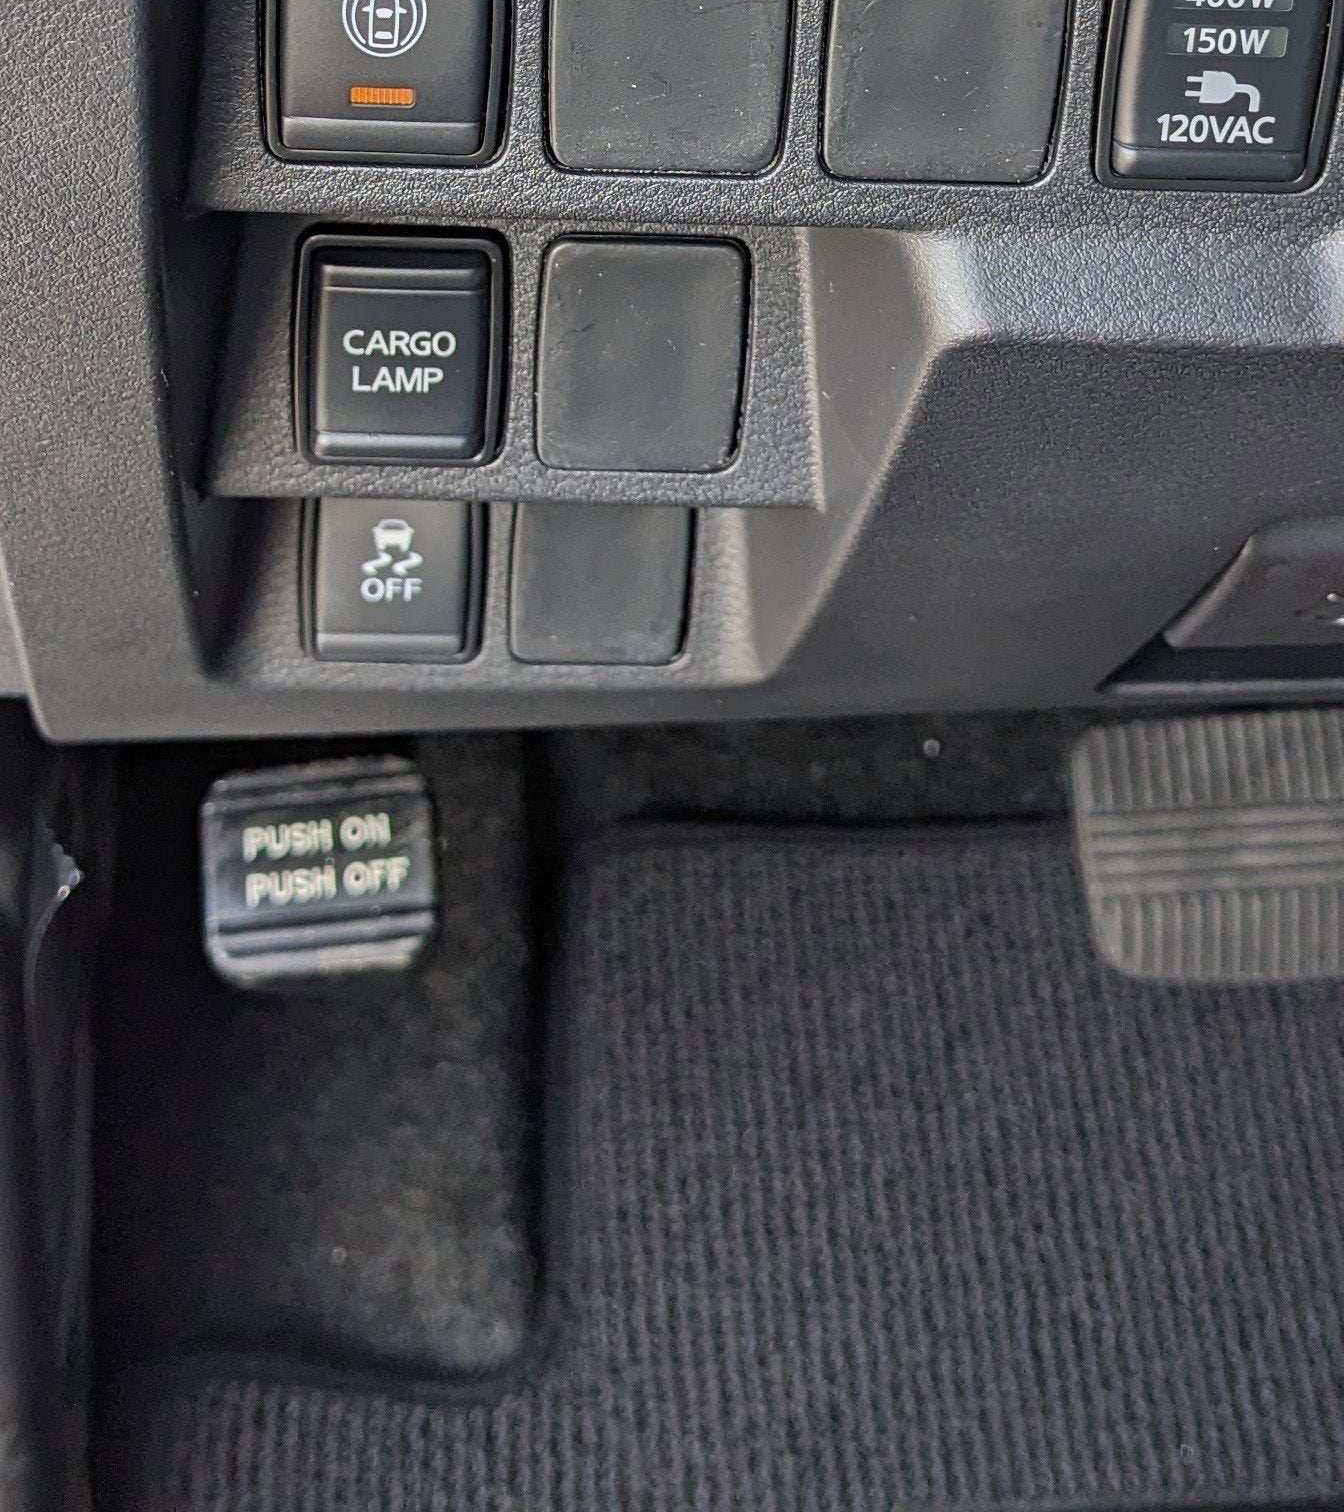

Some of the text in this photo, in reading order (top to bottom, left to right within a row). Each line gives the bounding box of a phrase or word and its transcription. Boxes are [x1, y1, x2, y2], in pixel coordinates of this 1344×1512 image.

[1183, 27, 1270, 55] 150W
[1157, 113, 1276, 144] 120VAC
[342, 329, 456, 357] CARGO
[352, 365, 444, 393] LAMP
[360, 577, 423, 603] OFF
[242, 812, 392, 863] PUSH ON
[245, 856, 410, 909] PUSH OFF
